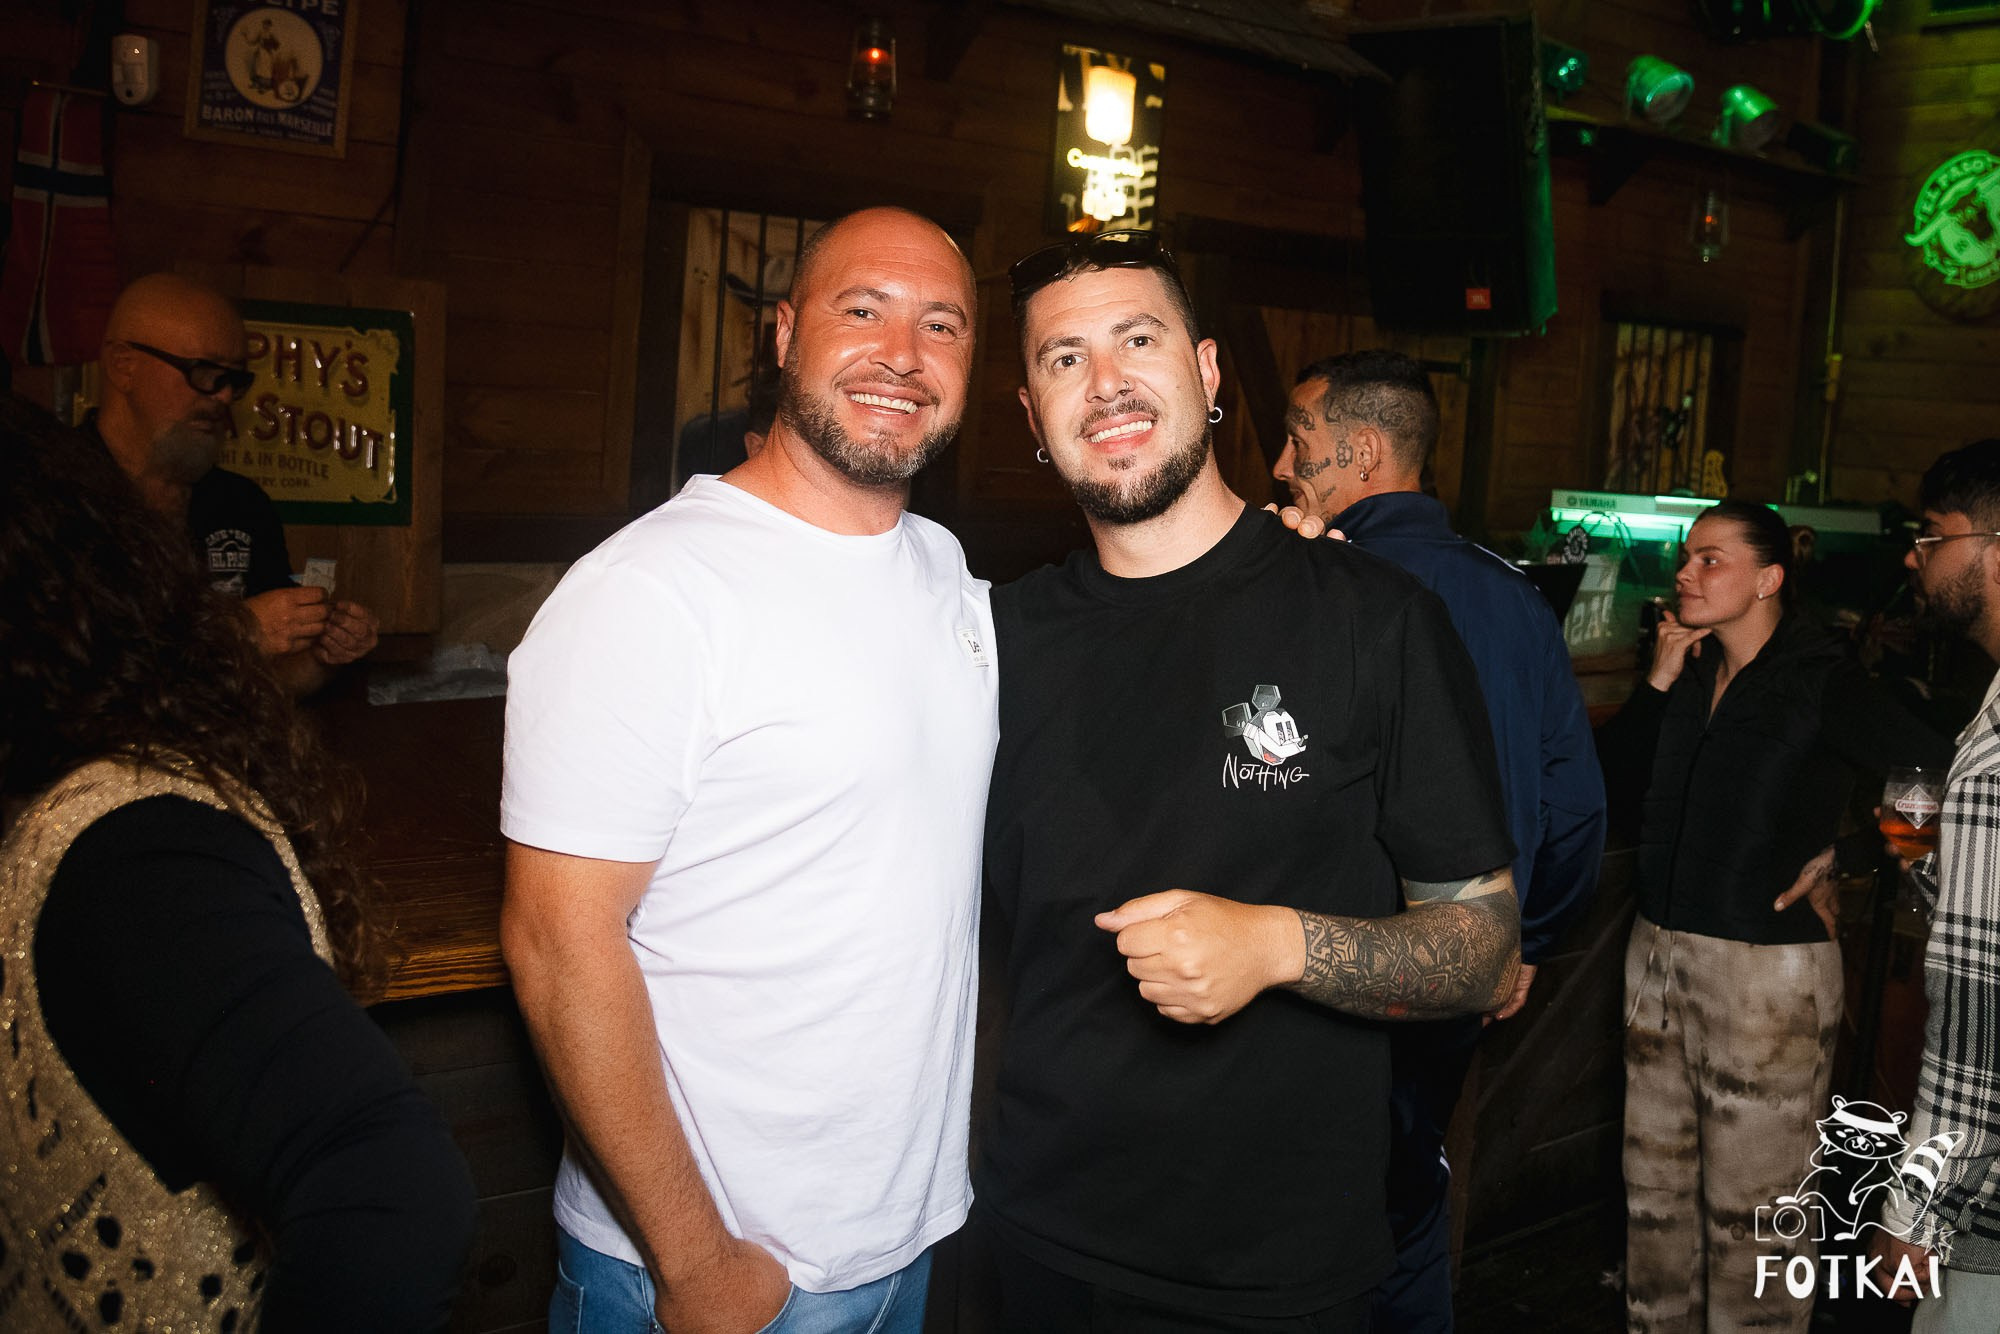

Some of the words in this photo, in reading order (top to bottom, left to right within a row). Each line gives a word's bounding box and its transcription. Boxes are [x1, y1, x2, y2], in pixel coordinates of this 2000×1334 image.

[202, 104, 254, 121] BARON
[277, 111, 333, 137] MARSEILLE
[246, 332, 369, 397] PHY'S
[253, 392, 383, 471] STOUT
[258, 451, 272, 467] IN
[278, 454, 330, 479] BOTTLE
[1577, 496, 1616, 509] YAMAHA
[1222, 753, 1310, 791] NOTHING
